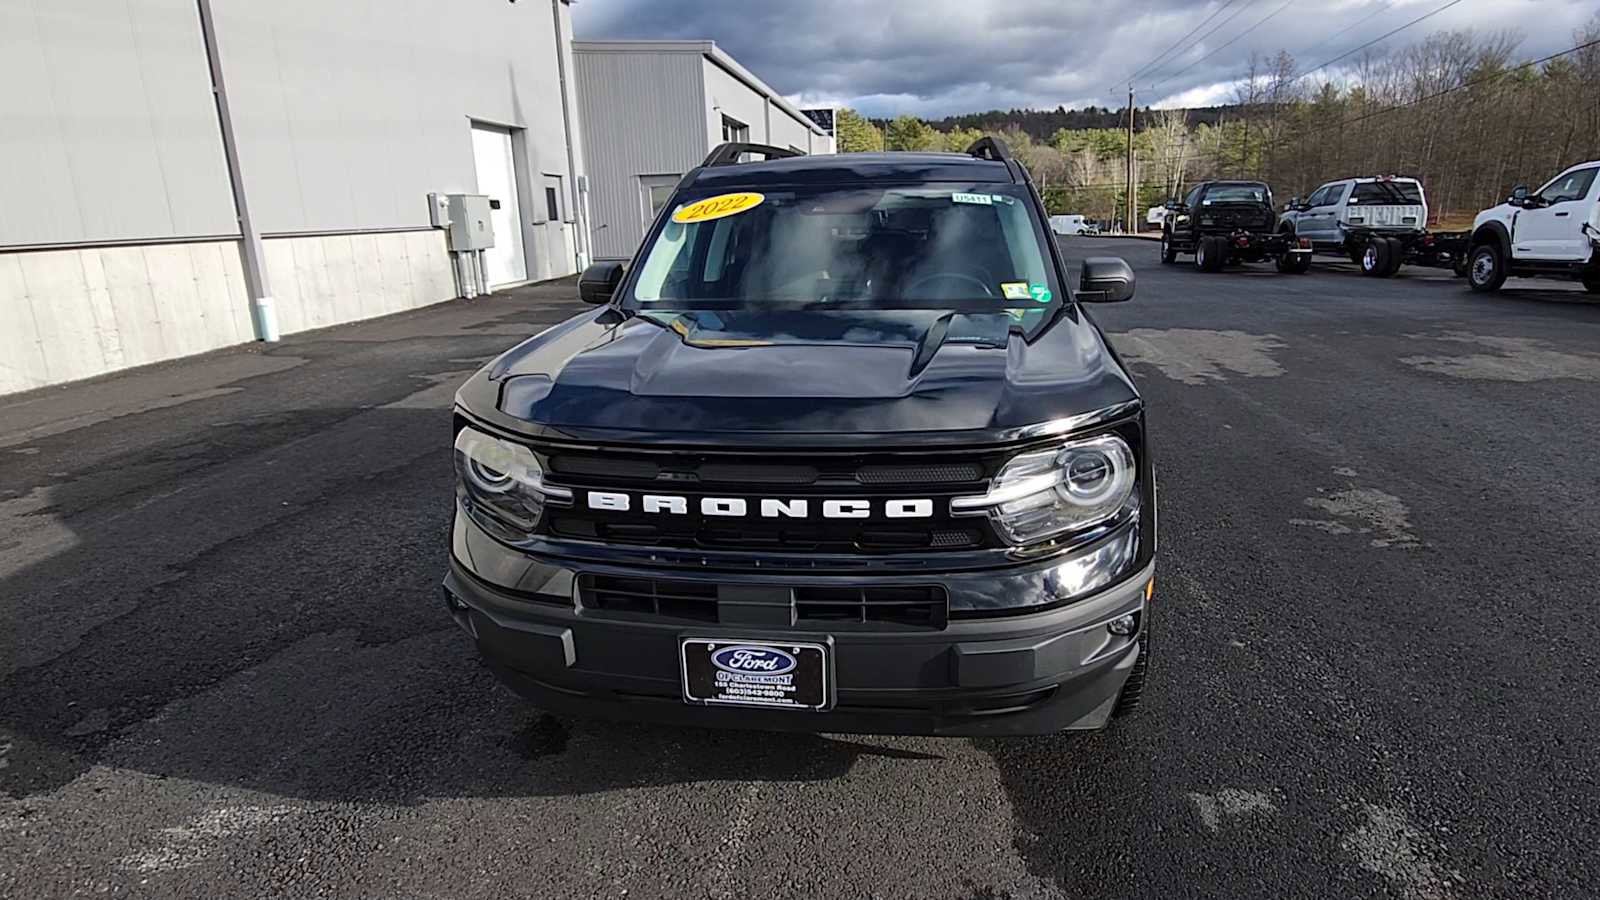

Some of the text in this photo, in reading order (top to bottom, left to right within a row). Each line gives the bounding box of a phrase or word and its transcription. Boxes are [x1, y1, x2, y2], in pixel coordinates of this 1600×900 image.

[687, 196, 748, 220] 2022
[587, 491, 933, 518] BRONCO
[728, 649, 778, 671] Ford
[716, 671, 793, 685] OF CLAREMONT
